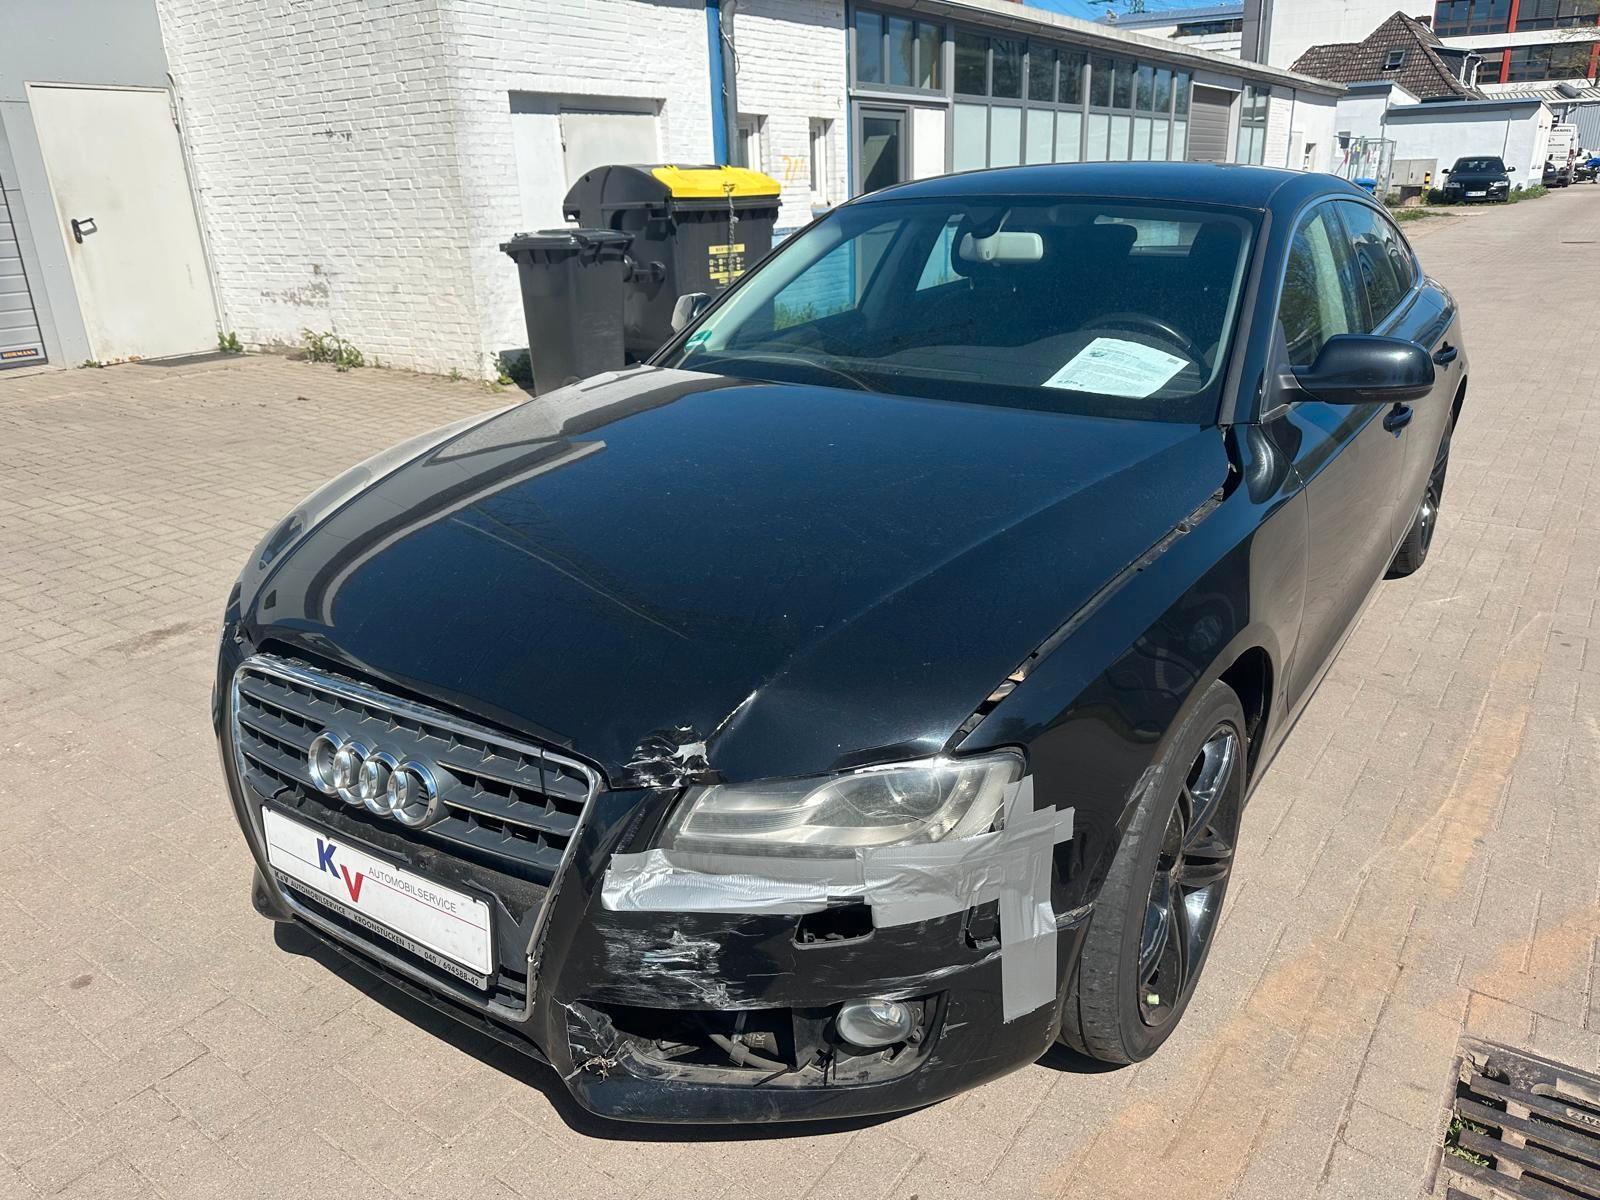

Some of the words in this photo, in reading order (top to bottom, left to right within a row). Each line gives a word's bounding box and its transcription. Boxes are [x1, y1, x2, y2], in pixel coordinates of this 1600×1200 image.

[290, 880, 346, 915] AUTOMOBILSERVICE
[424, 951, 437, 964] 040
[369, 866, 457, 914] AUTOMOBILSERVICE
